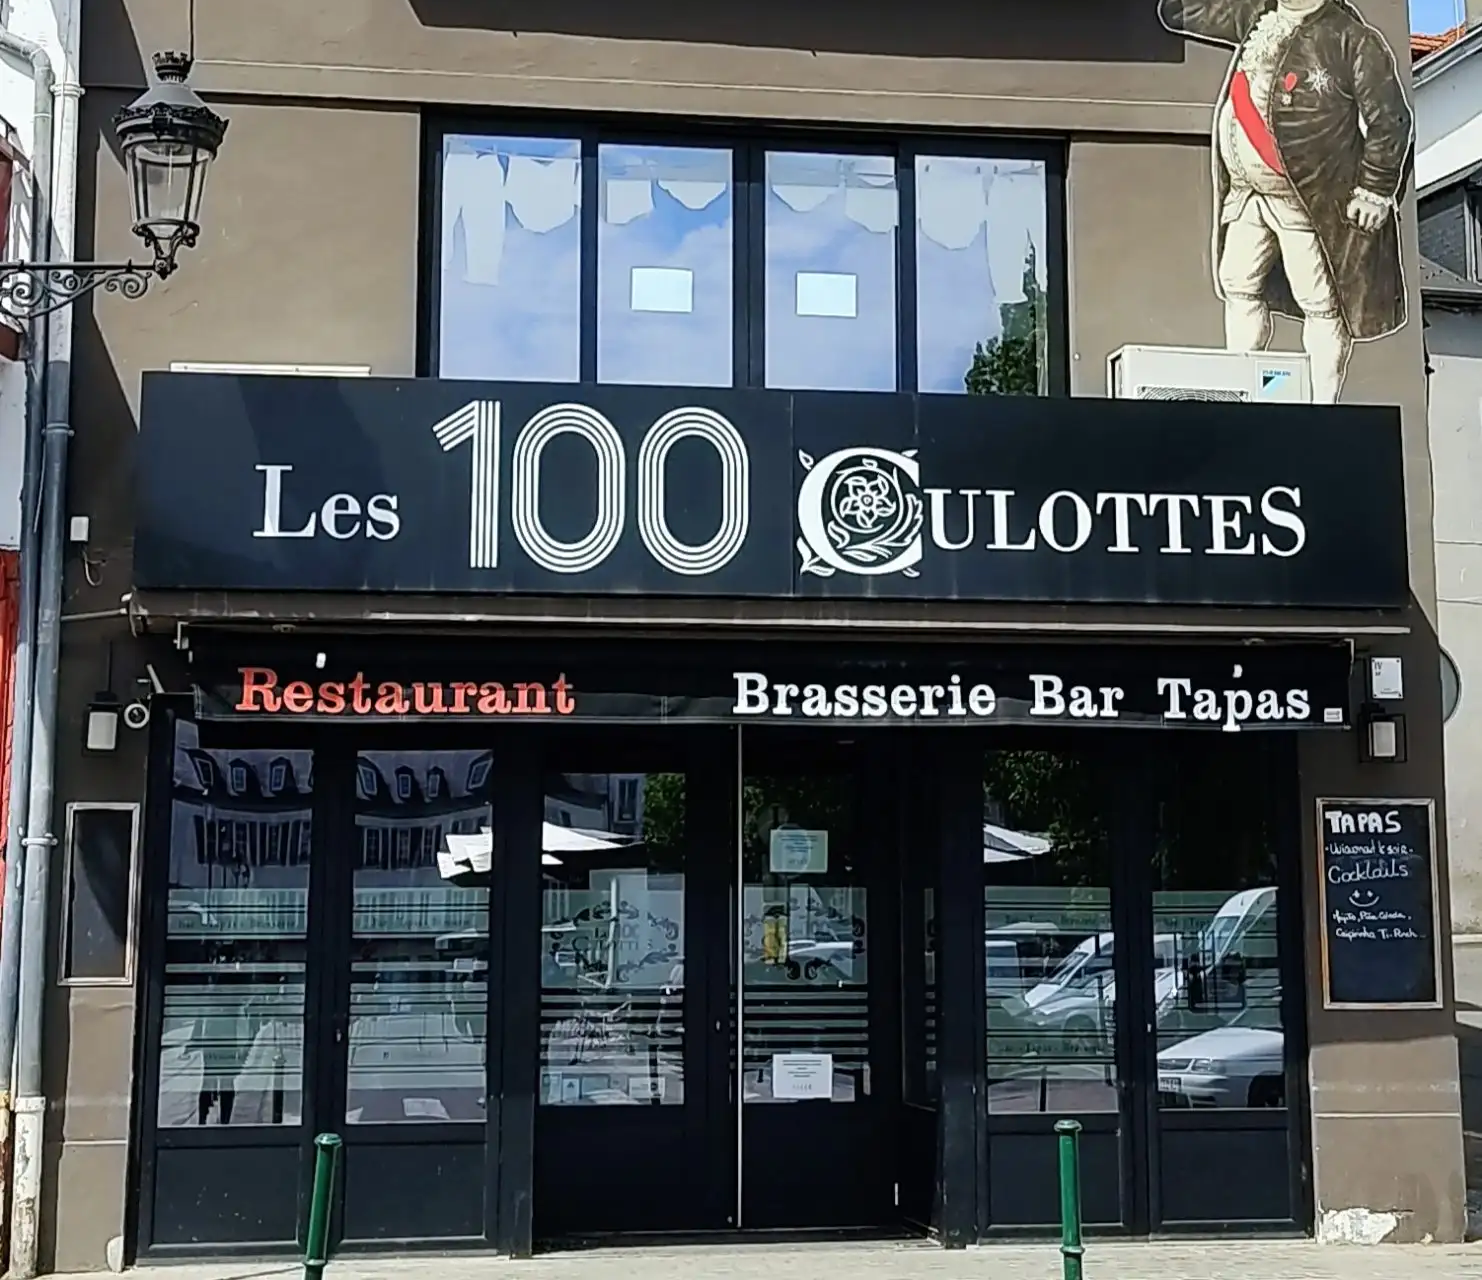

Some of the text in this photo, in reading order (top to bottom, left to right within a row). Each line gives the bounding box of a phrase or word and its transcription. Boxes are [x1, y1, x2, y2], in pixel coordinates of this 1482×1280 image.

[253, 464, 400, 540] Les
[432, 400, 749, 575] 100
[235, 666, 1311, 732] Restaurant Brasserie Bar Tapas
[1324, 810, 1402, 834] TAPAS
